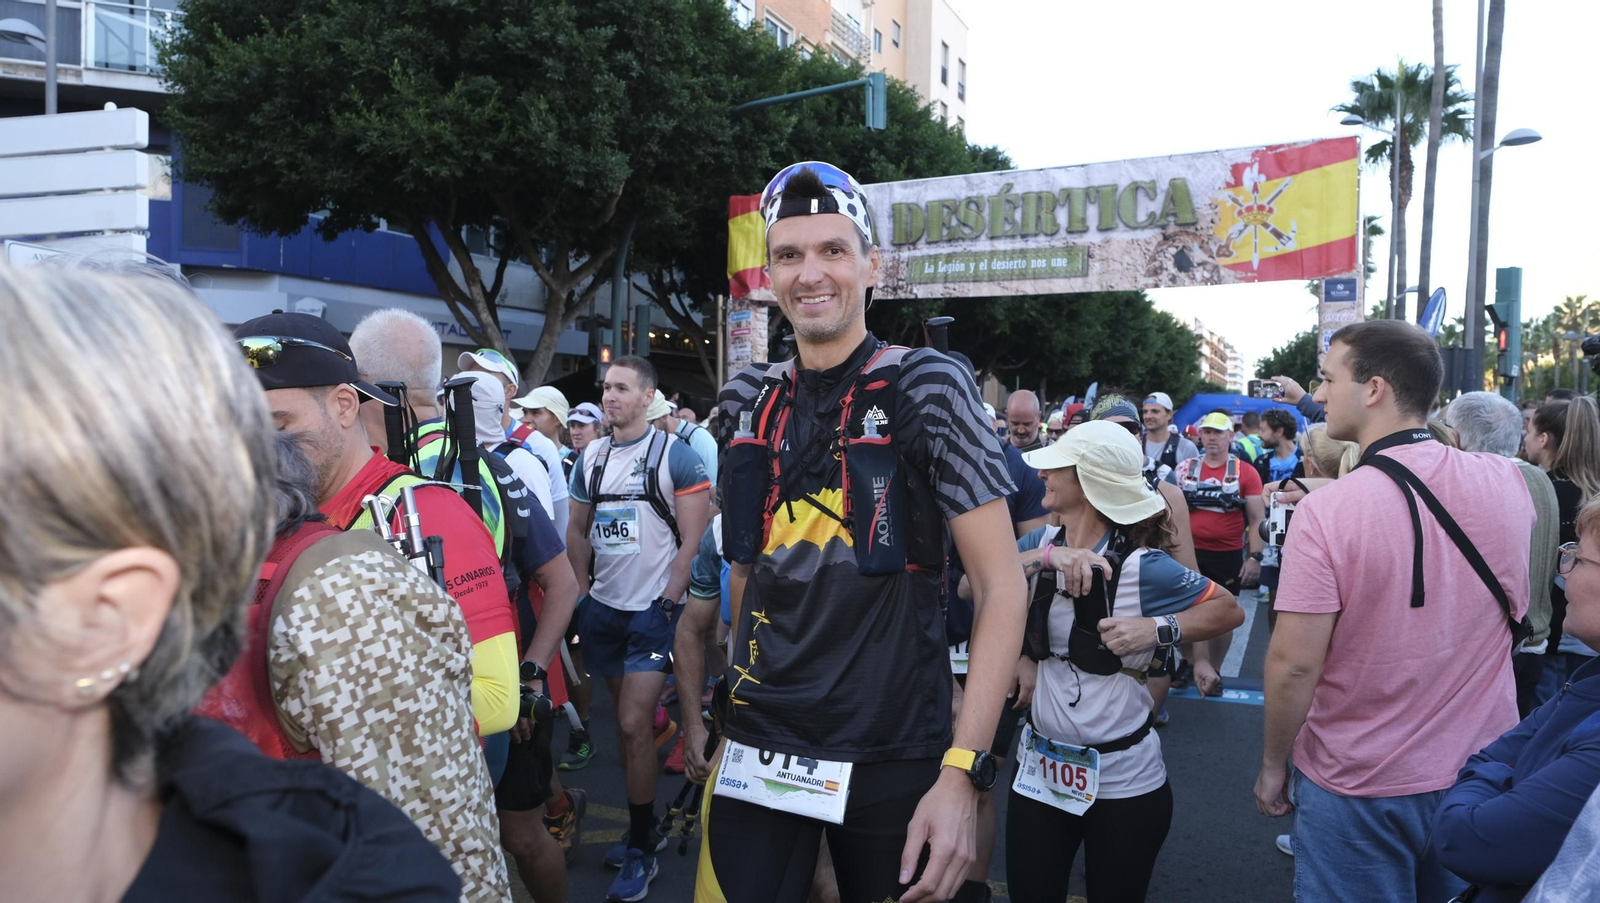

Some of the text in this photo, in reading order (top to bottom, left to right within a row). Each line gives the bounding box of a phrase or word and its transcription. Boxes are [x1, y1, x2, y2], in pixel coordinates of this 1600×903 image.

[891, 177, 1198, 246] DESÉRTICA
[924, 256, 1068, 275] La Legión y el desierto nos une
[1412, 432, 1432, 440] SONY
[595, 521, 630, 539] 1646
[453, 566, 496, 587] CANARIOS
[453, 586, 474, 600] Desde
[719, 776, 743, 789] asisa
[775, 770, 825, 788] ANTUANADRI
[1039, 755, 1088, 792] 1105
